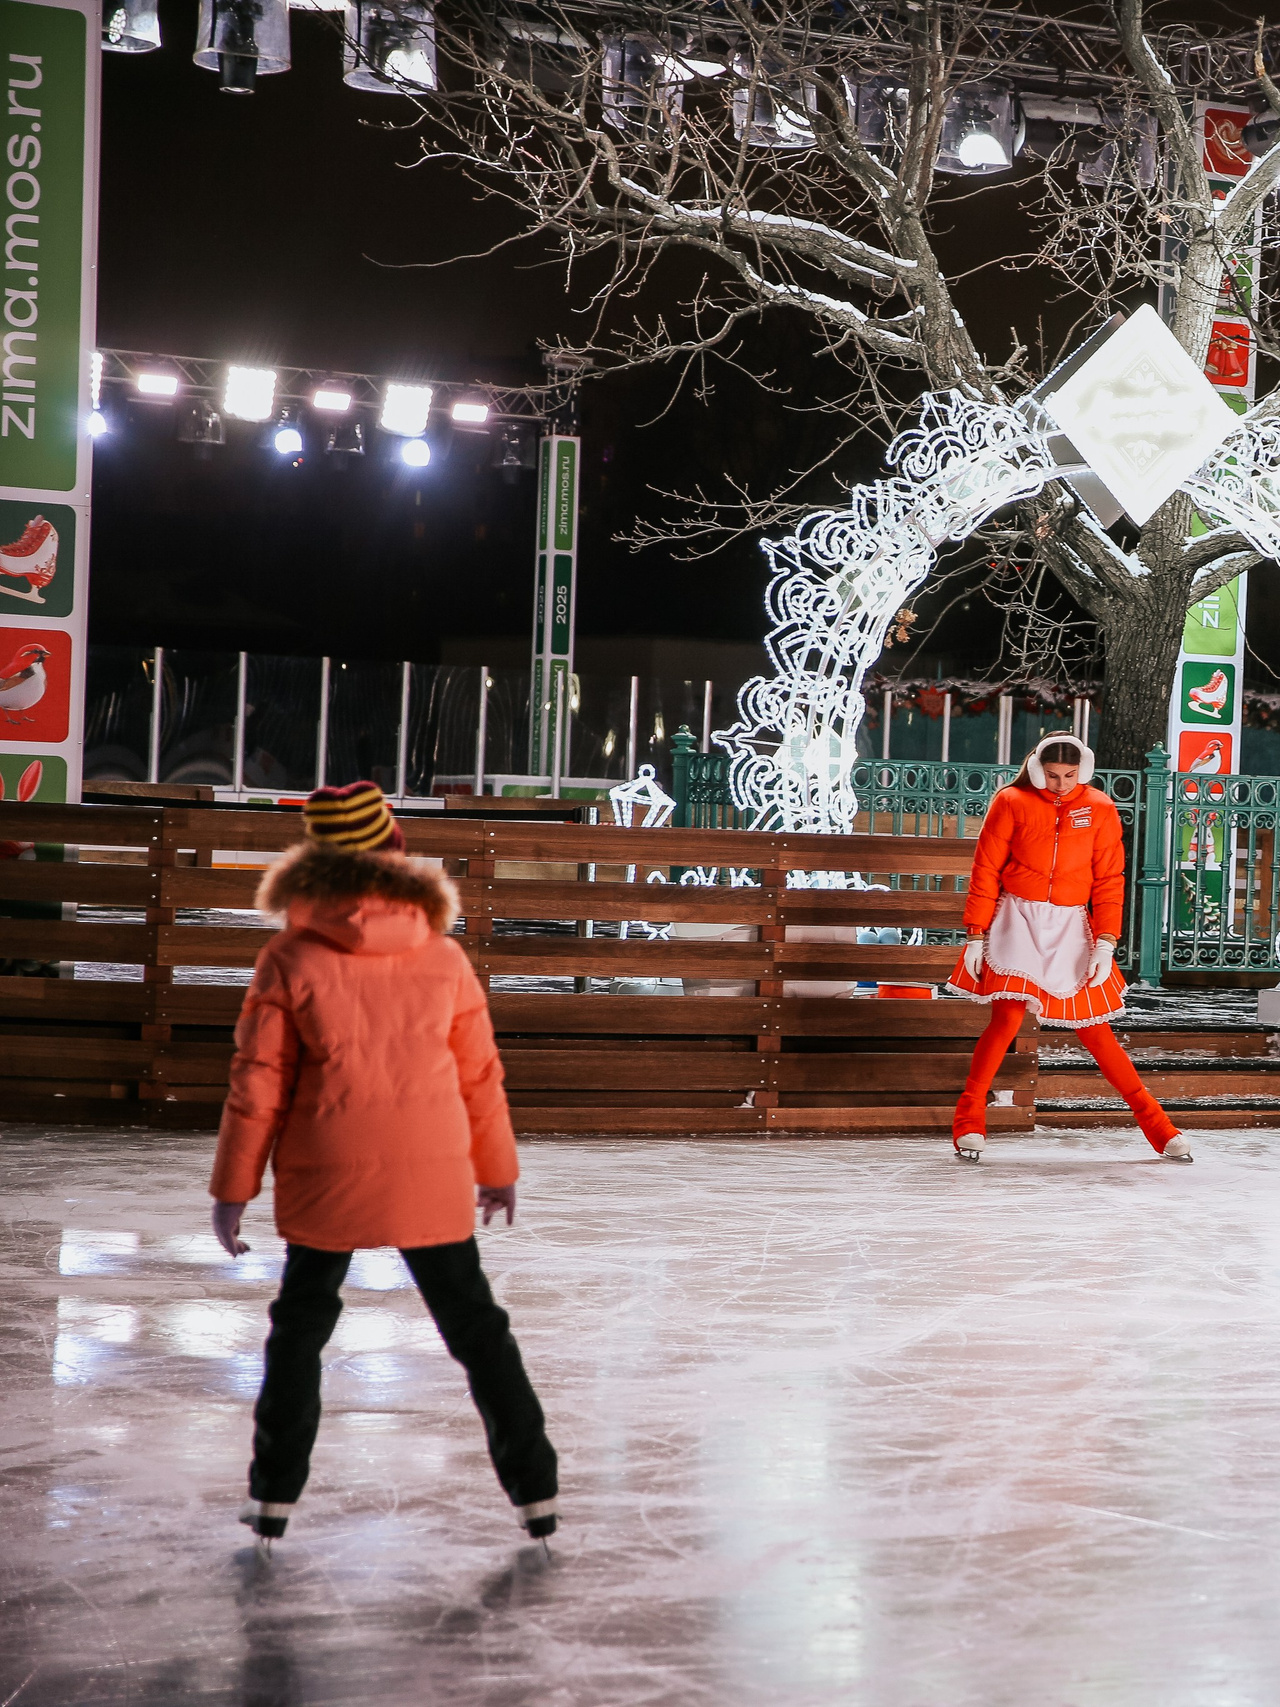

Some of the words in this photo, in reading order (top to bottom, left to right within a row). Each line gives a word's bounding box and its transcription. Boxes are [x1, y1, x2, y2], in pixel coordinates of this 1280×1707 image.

[1, 53, 43, 440] zima.mos.ru
[559, 455, 571, 536] zima.mos.ru
[556, 585, 567, 625] 2025
